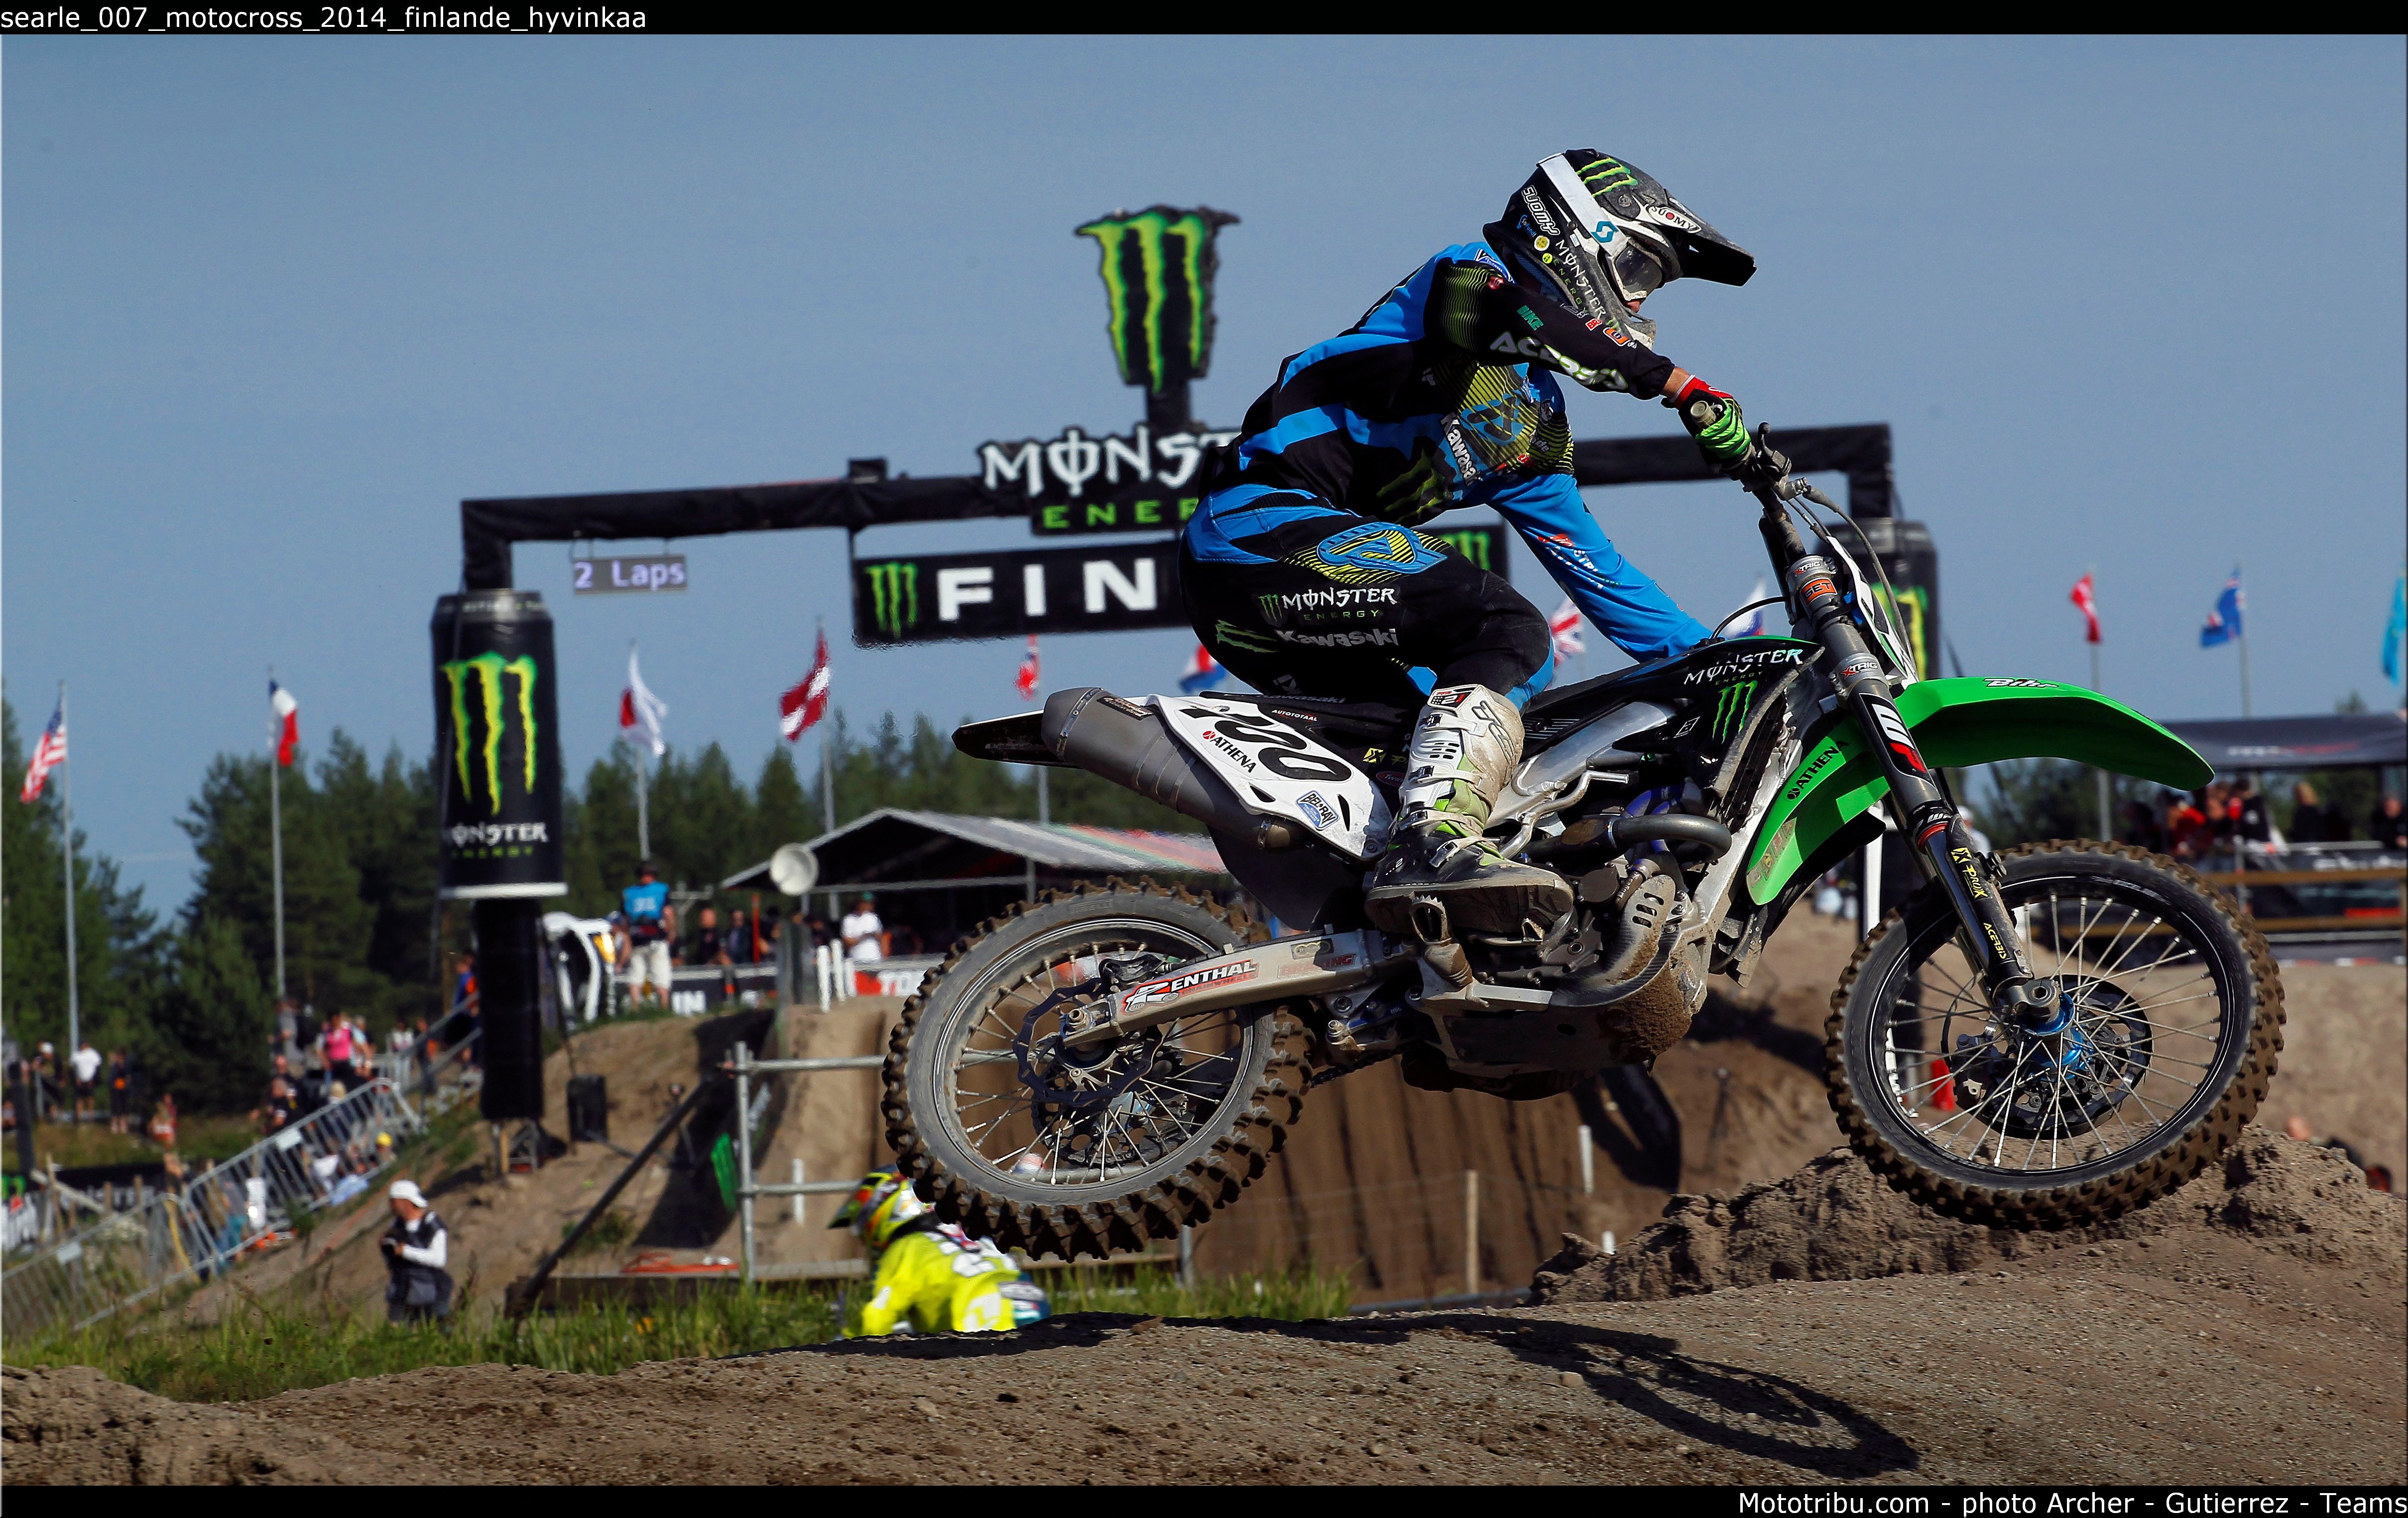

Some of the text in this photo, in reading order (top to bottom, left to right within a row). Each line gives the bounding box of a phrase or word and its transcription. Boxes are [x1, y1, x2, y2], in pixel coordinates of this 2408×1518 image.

[1522, 185, 1560, 235] SUOMY
[1552, 258, 1588, 314] ENERGY
[1556, 240, 1606, 319] MONSTER
[1517, 305, 1544, 330] BIKE
[575, 560, 685, 590] 2 Laps
[1794, 561, 1821, 576] XTRIG
[1281, 587, 1398, 611] MONSTER
[1303, 609, 1379, 621] ENERGY
[1274, 628, 1399, 647] Kawasaki
[1684, 649, 1804, 685] MONSTER
[1715, 671, 1763, 686] ENERGY
[1840, 662, 1878, 680] XTRIG
[1271, 709, 1318, 722] AUTOTOTAAL
[1210, 737, 1257, 773] ATHENA
[1796, 741, 1849, 789] ATHENA
[1983, 922, 2008, 960] ACERBIS
[1124, 962, 1257, 1013] RENTHAL
